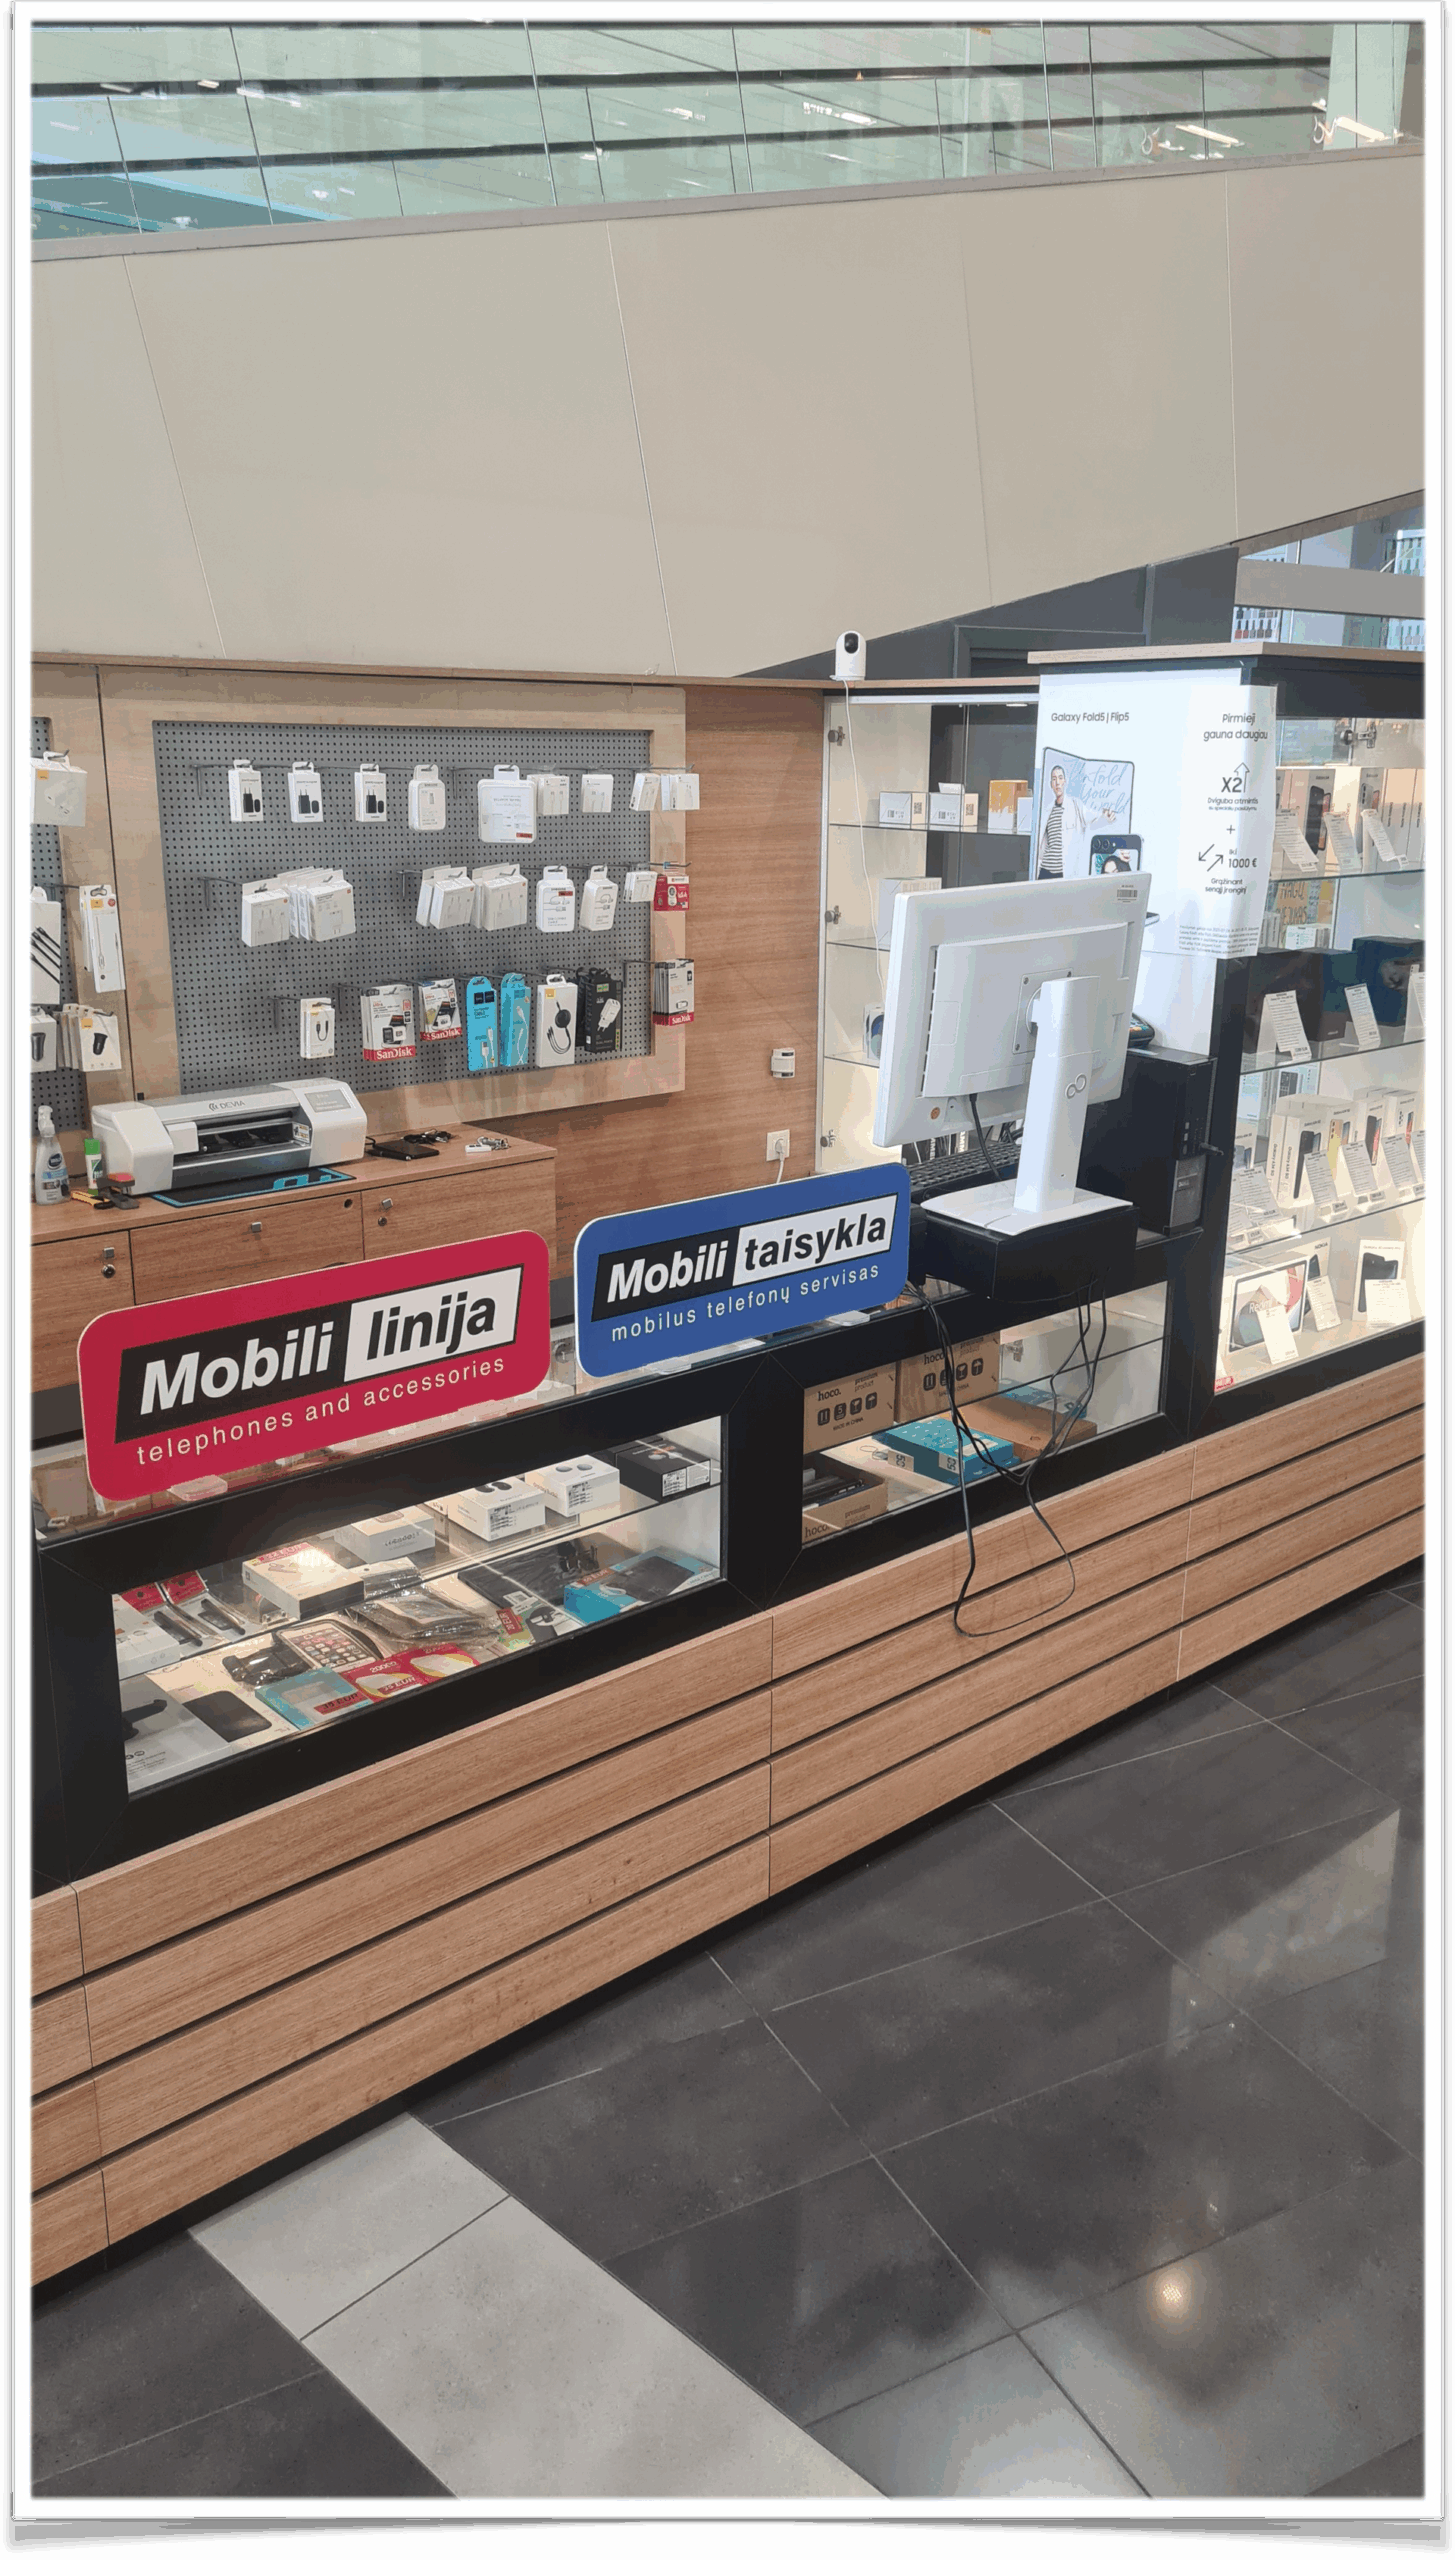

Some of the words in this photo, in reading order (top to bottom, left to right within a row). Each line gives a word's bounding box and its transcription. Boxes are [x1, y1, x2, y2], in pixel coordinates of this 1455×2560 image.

[1051, 712, 1081, 725] Galaxy
[1082, 711, 1105, 722] Fold5
[1110, 711, 1130, 725] Flip5
[1222, 712, 1256, 726] Pirmieji
[1203, 730, 1233, 742] gauna
[1235, 729, 1268, 742] daugiau
[1220, 777, 1243, 793] X2
[1207, 797, 1233, 806] Dviguba
[1234, 797, 1259, 805] atmintis
[1229, 858, 1250, 869] 1000
[1252, 857, 1258, 868] €
[1211, 877, 1243, 886] Grąžinant
[431, 1028, 460, 1041] SanDisk
[376, 1047, 412, 1060] SanDisk
[219, 1100, 246, 1109] DEVIA
[607, 1240, 729, 1303] Mobili
[744, 1213, 887, 1271] taisykla
[612, 1310, 696, 1342] mobilus
[707, 1286, 790, 1318] telefonų
[800, 1264, 879, 1296] servisas
[140, 1320, 335, 1415] Mobili
[366, 1291, 496, 1361] linija
[854, 1380, 874, 1393] product
[817, 1388, 842, 1402] hoco.
[137, 1411, 293, 1465] telephones
[305, 1394, 351, 1422] and
[364, 1356, 504, 1407] accessories
